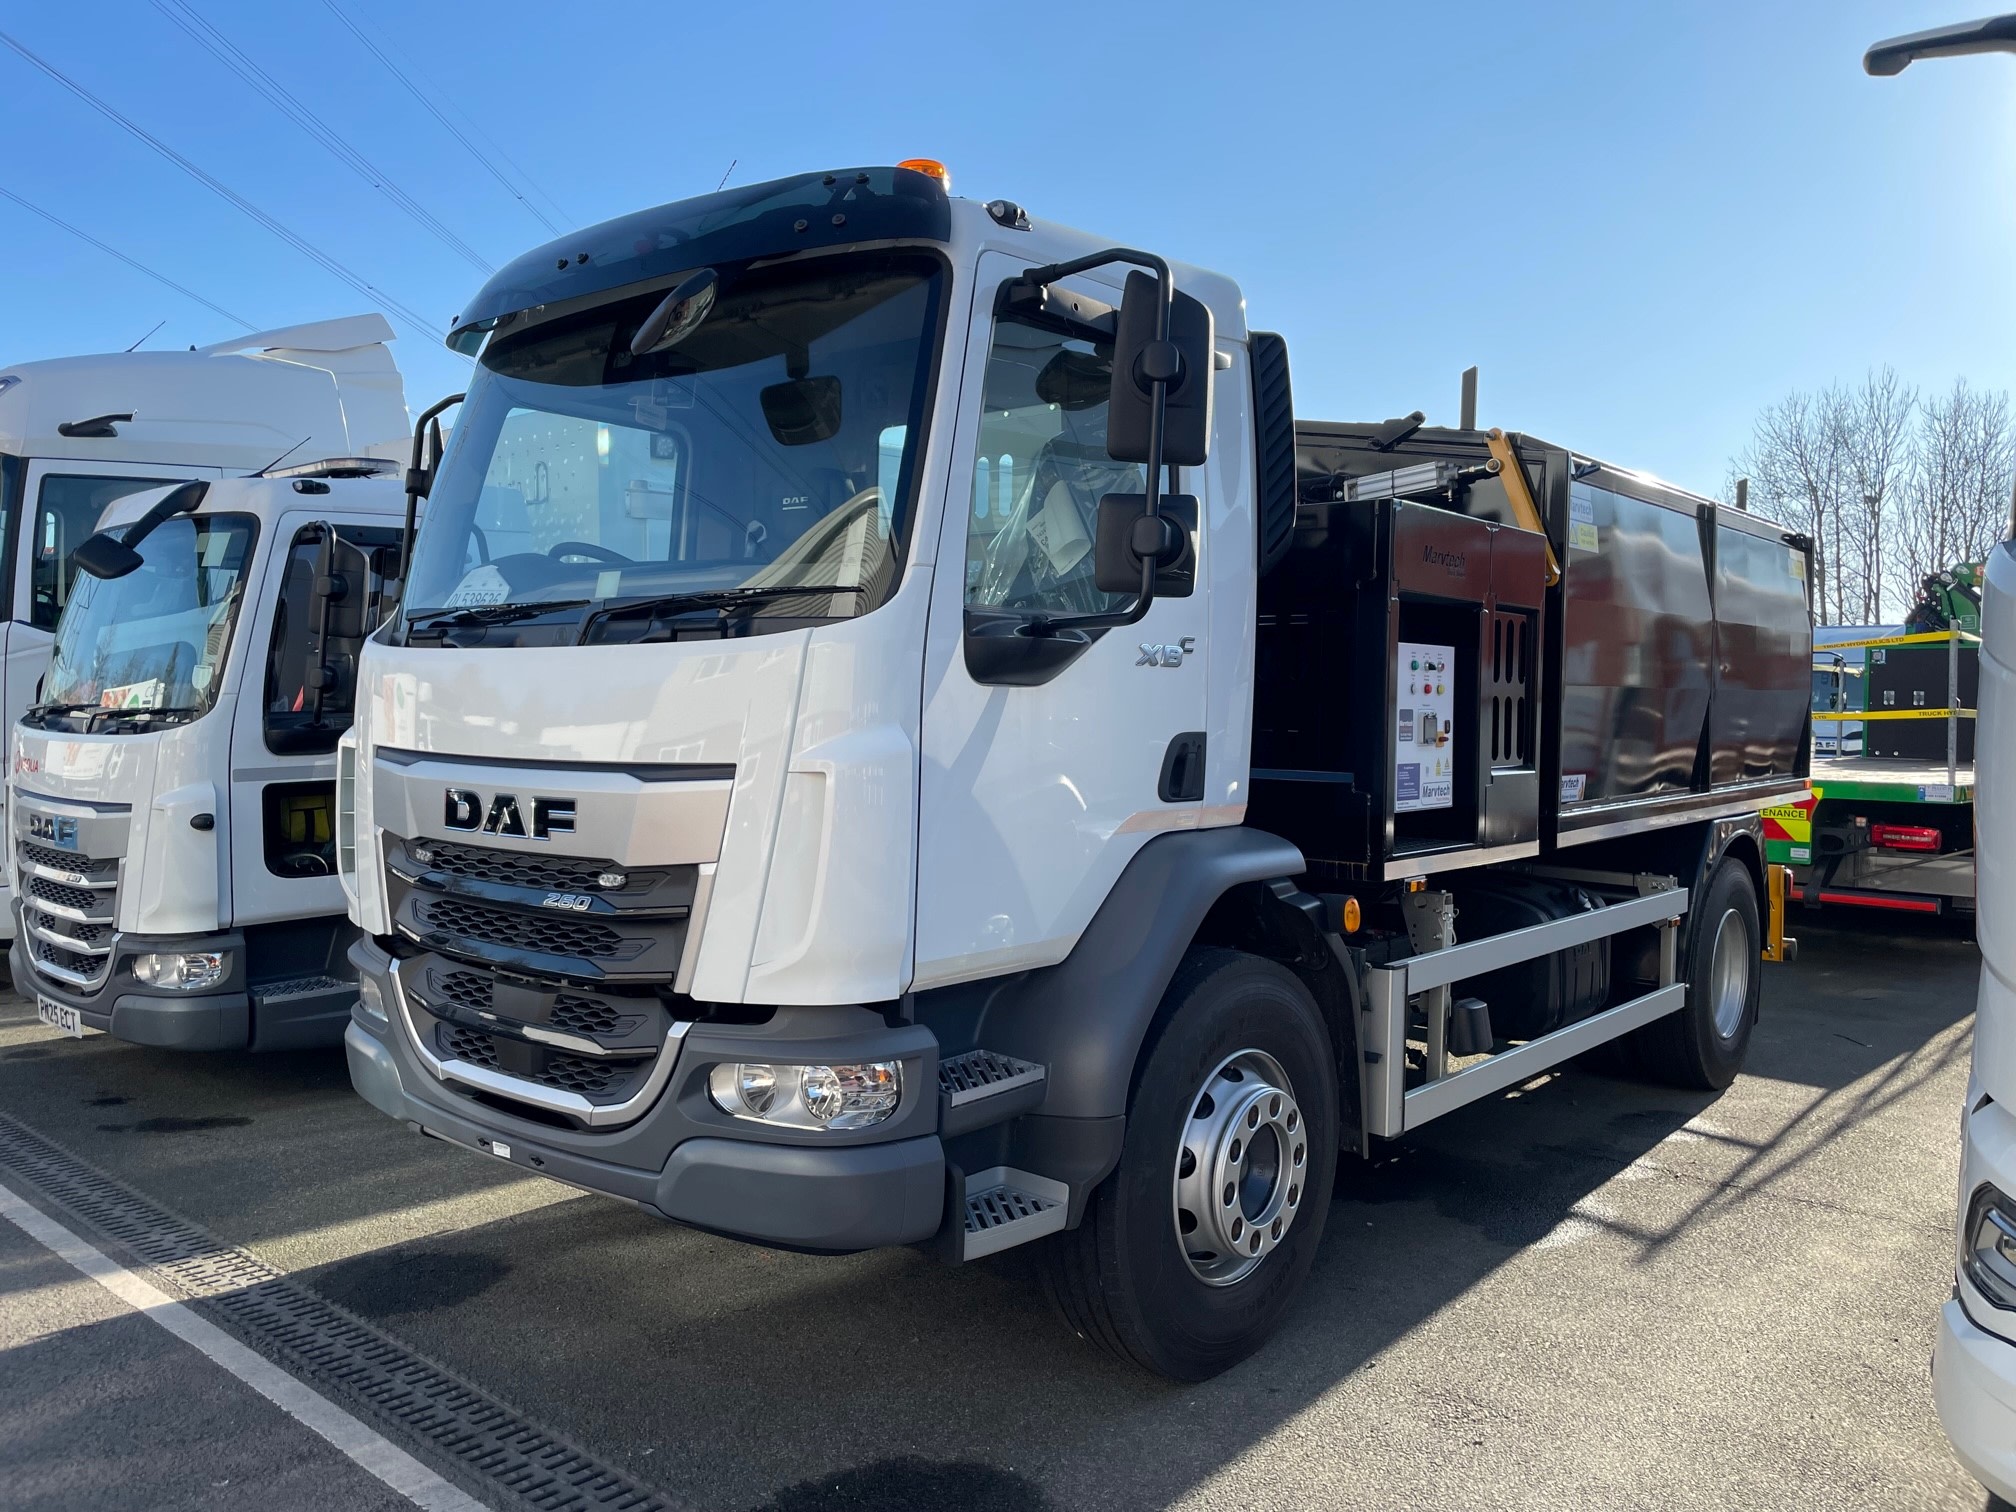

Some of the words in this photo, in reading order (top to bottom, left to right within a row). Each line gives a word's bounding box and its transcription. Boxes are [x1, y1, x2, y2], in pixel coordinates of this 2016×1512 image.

[782, 496, 809, 505] DAF
[1422, 544, 1465, 568] Marvtech
[1847, 638, 1891, 647] HYDRAULICS
[1421, 783, 1450, 798] Marvtech
[444, 787, 578, 841] DAF
[30, 813, 78, 842] DAF
[543, 893, 592, 911] 260
